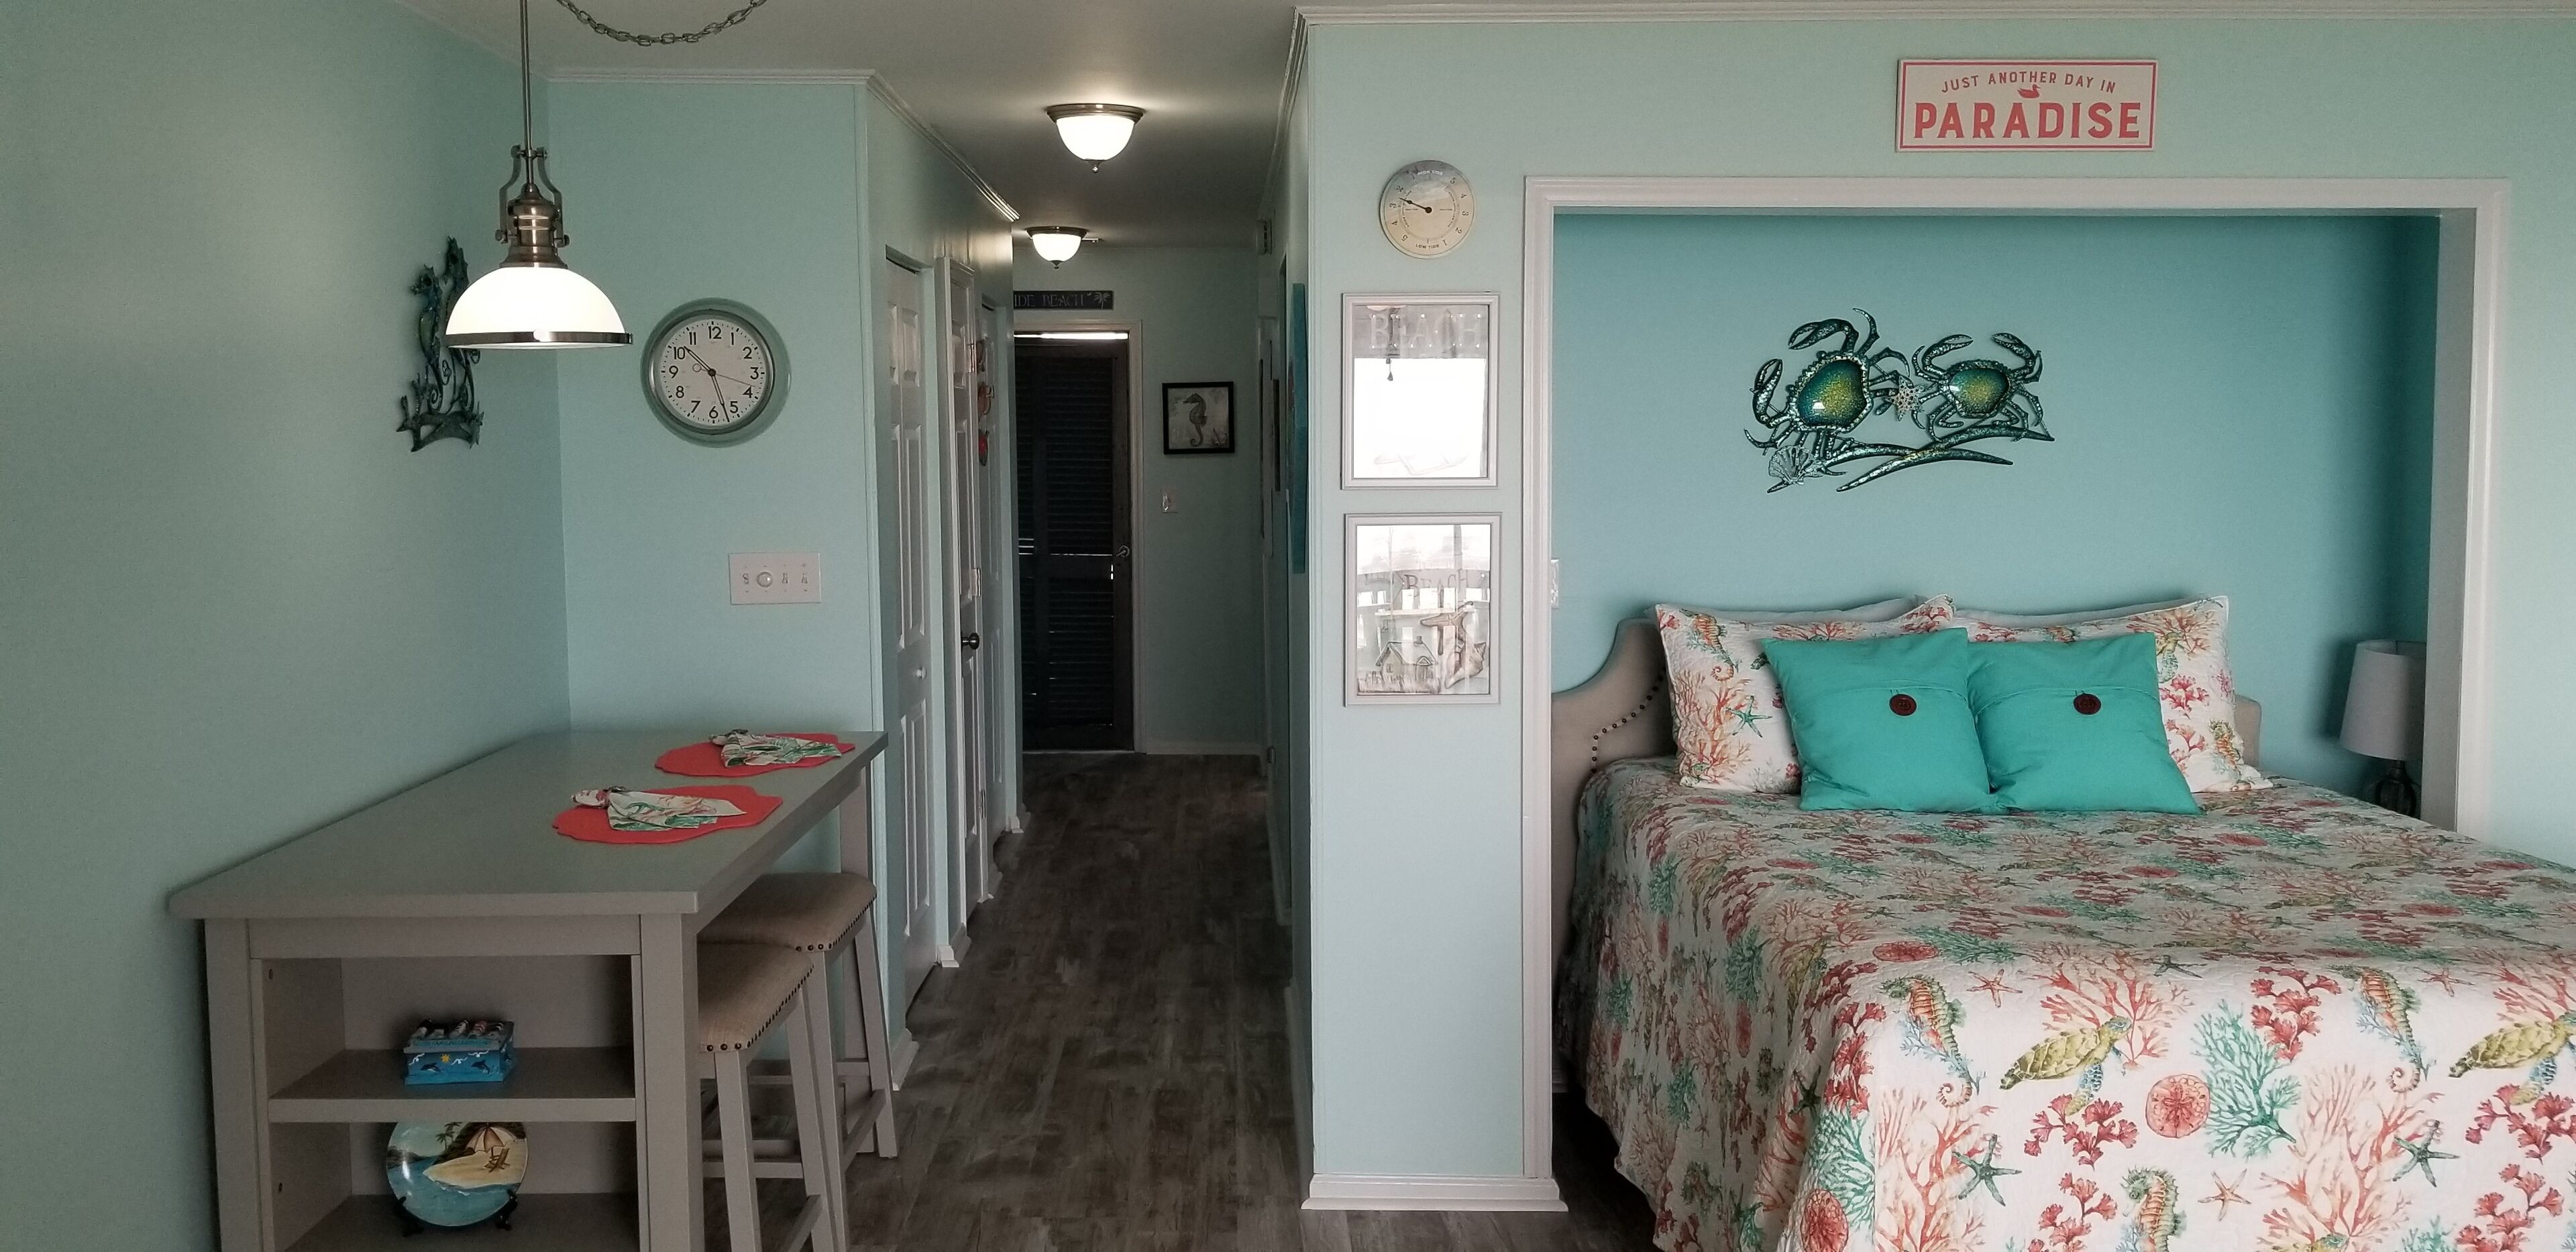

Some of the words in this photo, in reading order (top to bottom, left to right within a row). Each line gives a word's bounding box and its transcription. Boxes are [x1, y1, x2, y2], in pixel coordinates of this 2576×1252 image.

[1941, 74, 1979, 93] JUST
[1988, 70, 2057, 85] ANOTHER
[2064, 73, 2094, 89] DAY
[2100, 79, 2116, 94] IN
[1913, 102, 2141, 139] PARADISE
[1042, 294, 1084, 307] BEACH
[689, 332, 696, 345] 11
[708, 326, 722, 340] 12
[674, 347, 686, 360] 10
[743, 347, 752, 359] 2
[669, 366, 678, 378] 9
[750, 367, 759, 380] 3
[676, 386, 684, 398] 8
[743, 385, 753, 398] 4
[691, 401, 700, 413] 7
[709, 406, 718, 419] 6
[730, 401, 739, 413] 5
